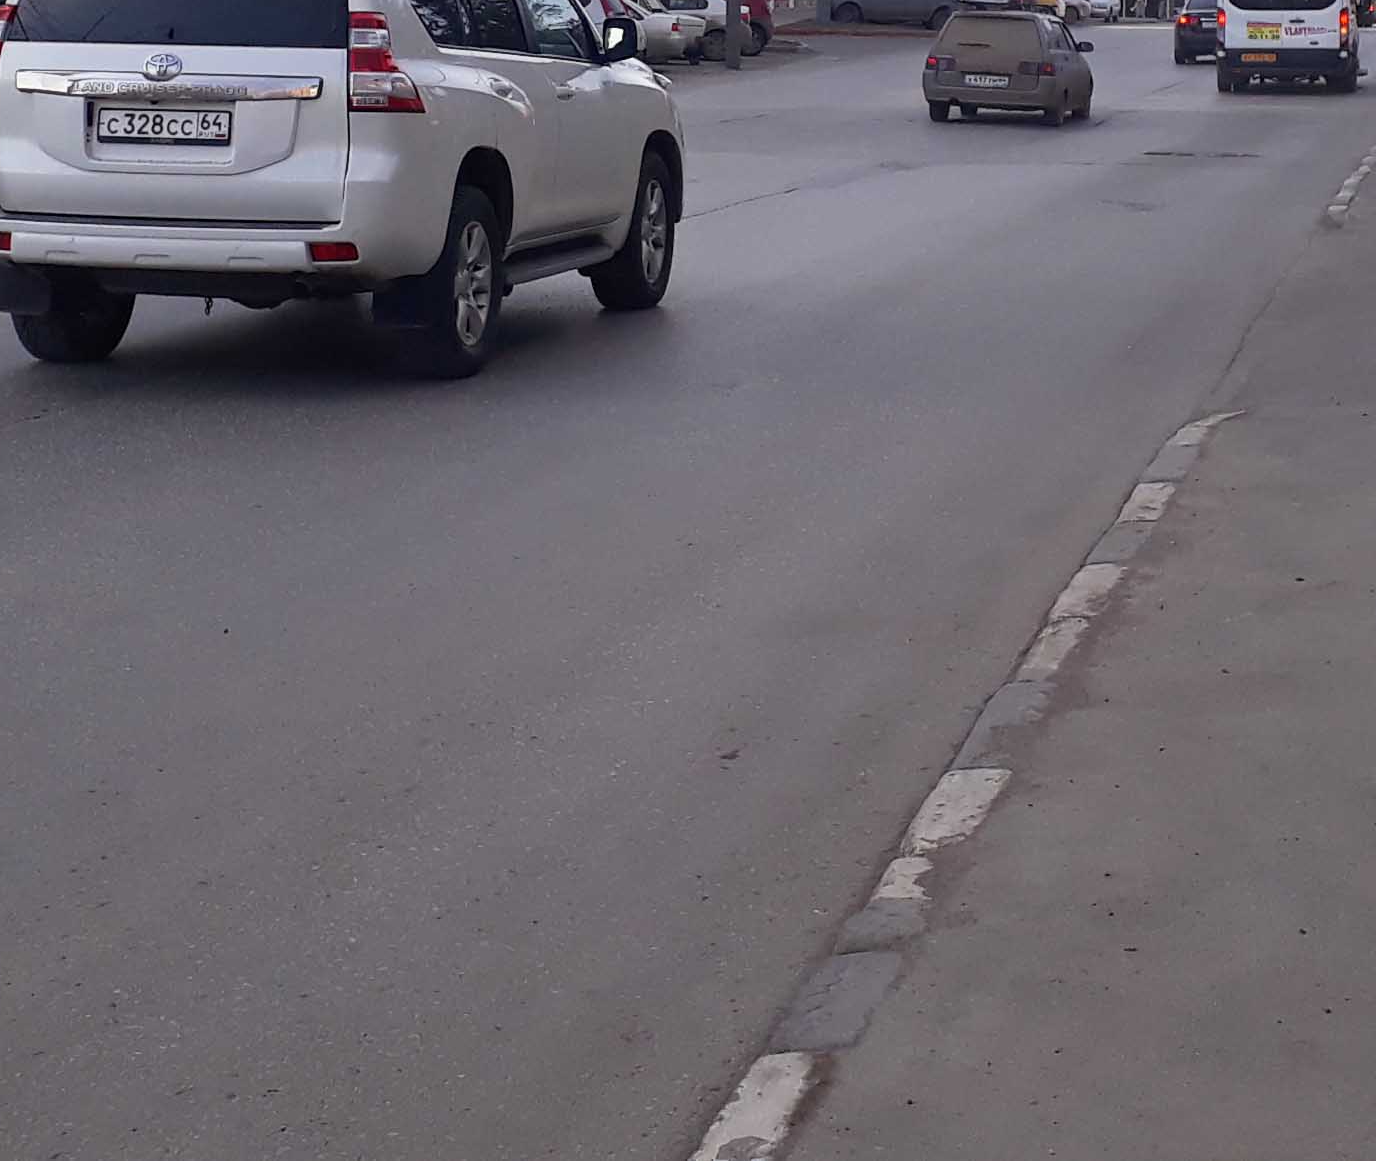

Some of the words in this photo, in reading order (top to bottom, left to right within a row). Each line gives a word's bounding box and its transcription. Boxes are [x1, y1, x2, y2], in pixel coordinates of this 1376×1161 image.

[74, 81, 115, 95] LAND
[118, 82, 187, 96] CRUISER
[200, 114, 222, 132] 64
